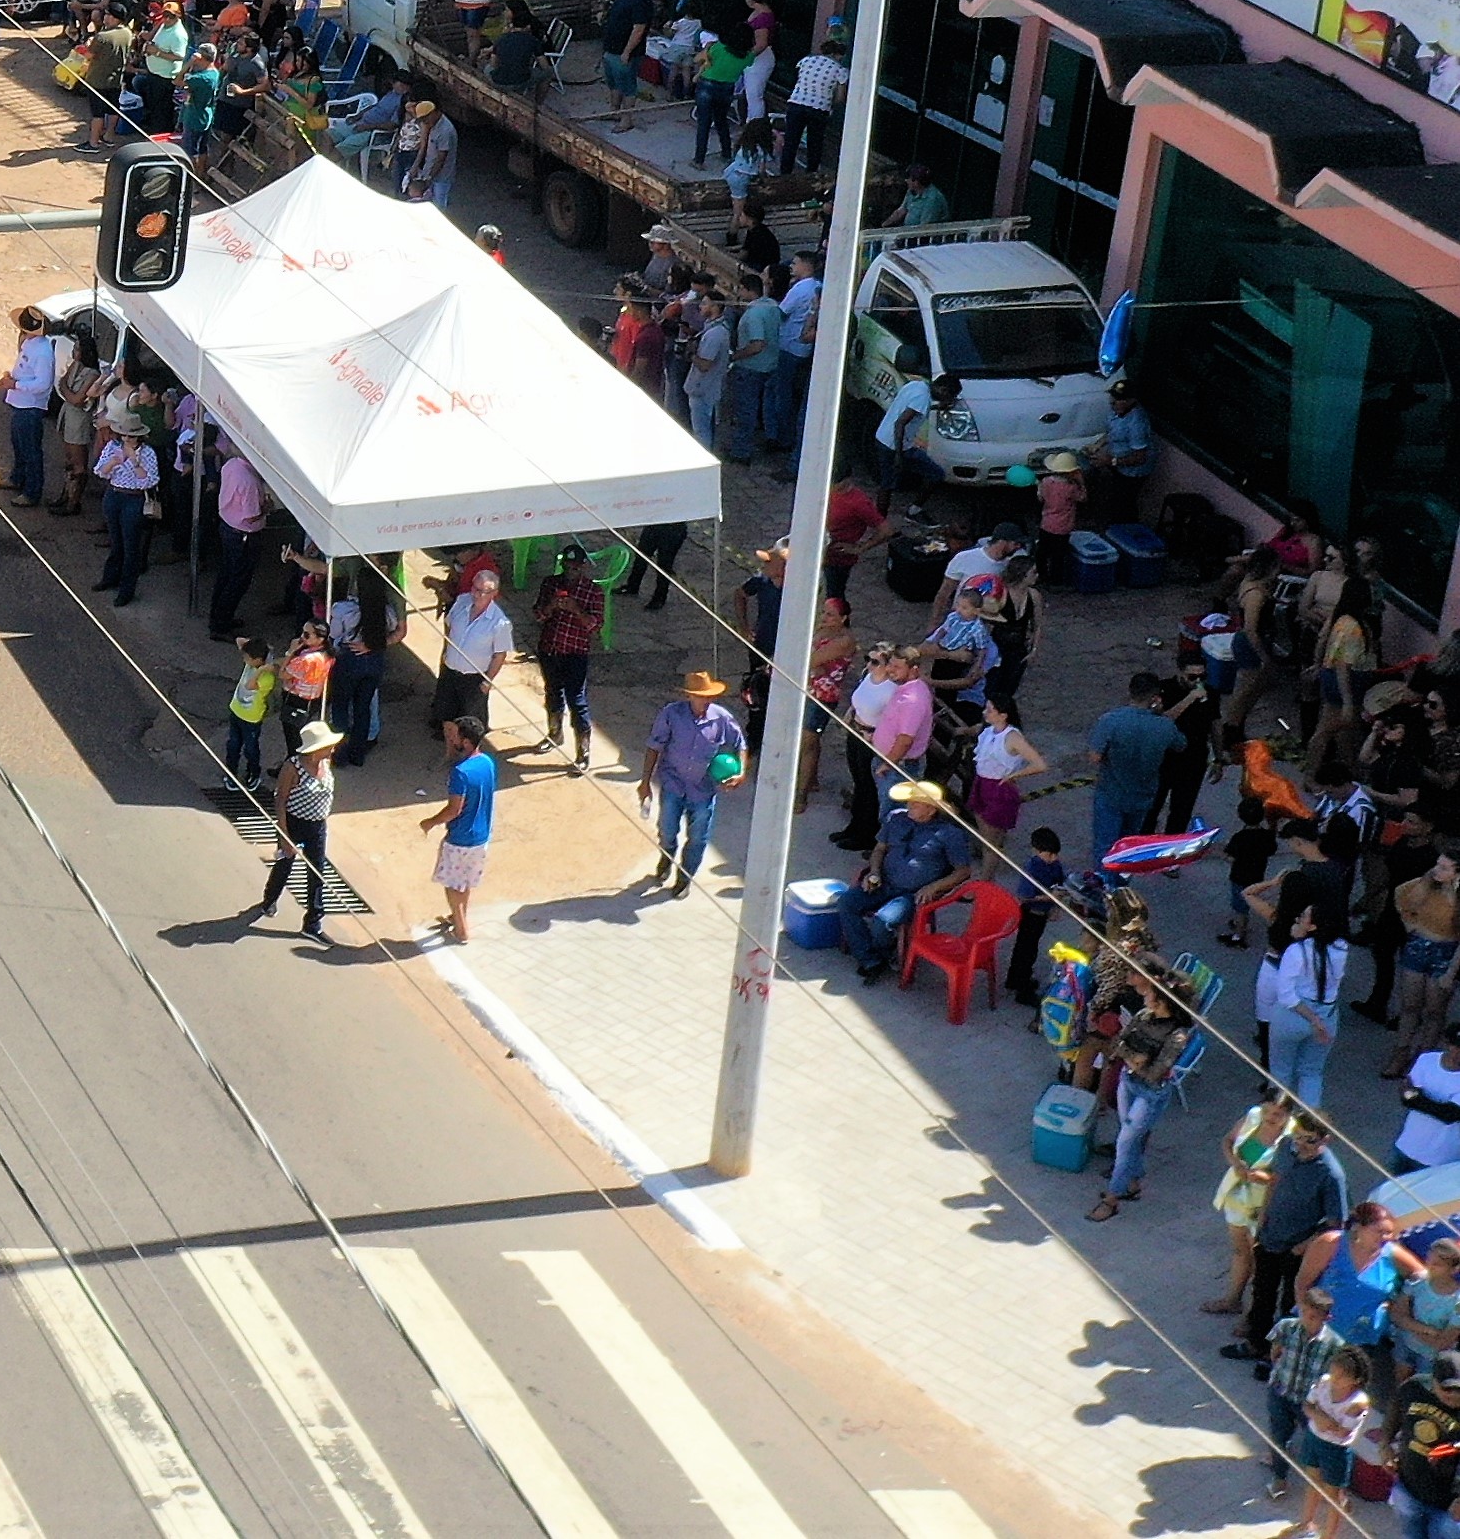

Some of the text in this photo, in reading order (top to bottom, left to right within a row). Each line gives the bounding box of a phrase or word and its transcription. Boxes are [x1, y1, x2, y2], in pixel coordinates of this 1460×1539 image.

[210, 217, 253, 265] Agrivalle
[335, 351, 387, 407] Agrivalle
[376, 516, 468, 534] Vida gerando vida
